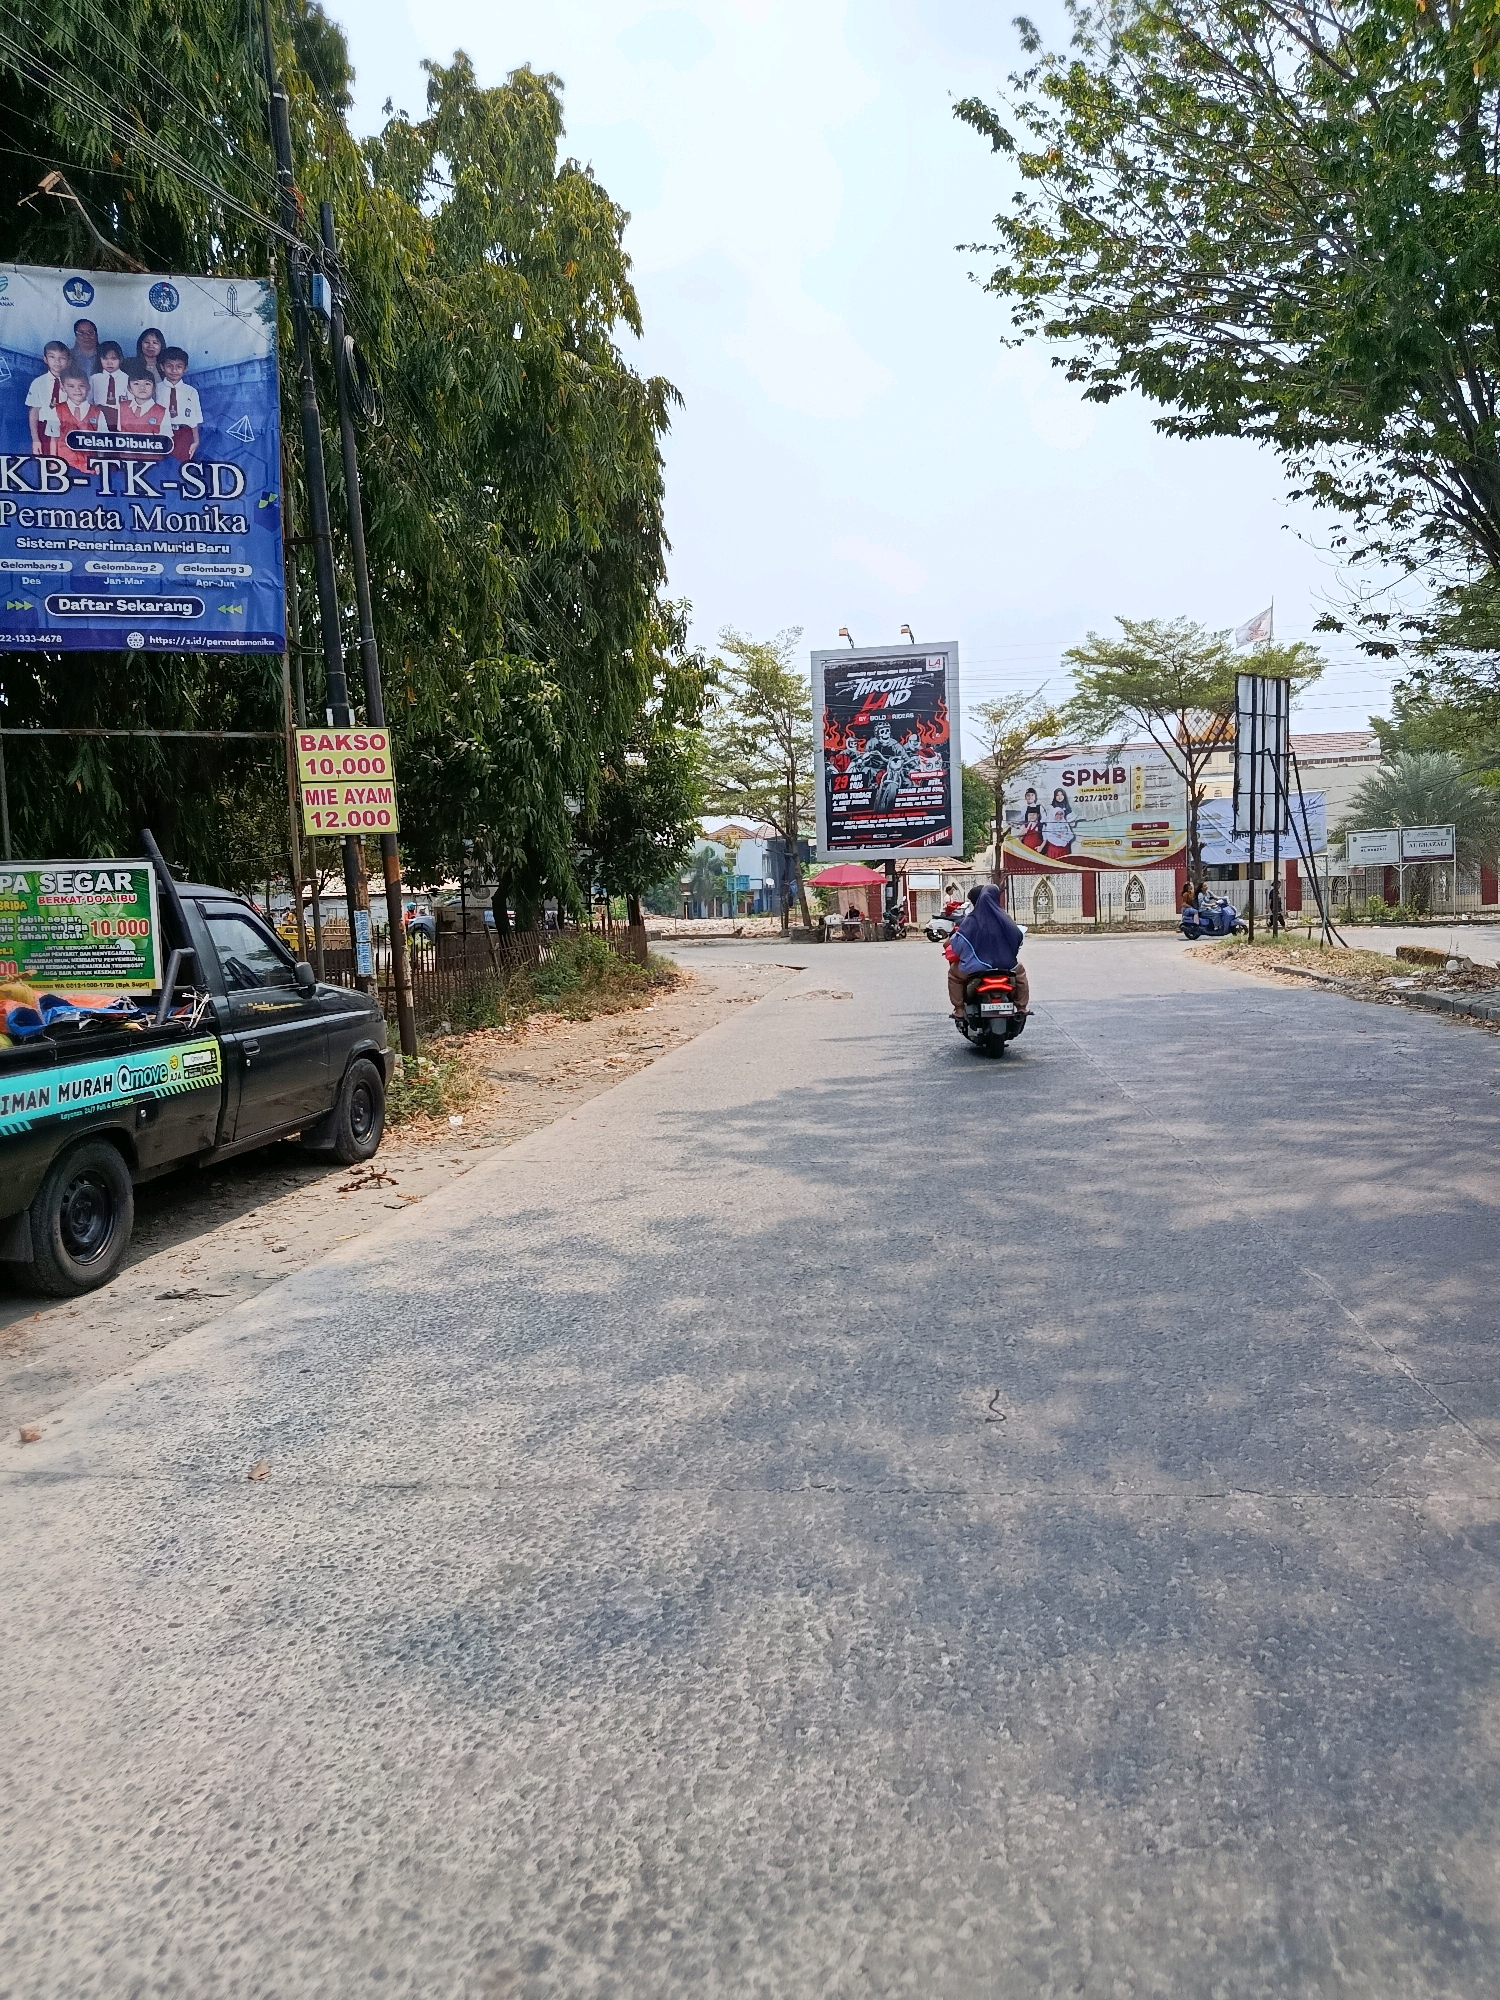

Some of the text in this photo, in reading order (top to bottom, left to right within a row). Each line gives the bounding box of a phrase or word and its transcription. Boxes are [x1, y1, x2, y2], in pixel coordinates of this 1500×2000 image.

[76, 435, 163, 450] Telah Dibuka
[0, 456, 246, 499] KB-TK-SD
[0, 501, 248, 534] Permata Monika
[16, 538, 230, 553] Sistem Penerimaan Murid Baru
[1, 561, 57, 570] Gelombang
[93, 563, 149, 572] Gelombang
[183, 565, 237, 574] Gelombang
[104, 577, 145, 585] Jan-Mar
[196, 580, 235, 588] Apr-Jun
[58, 599, 193, 615] Daftar Sekarang
[149, 636, 275, 647] https://s.id/permatamonika
[852, 675, 916, 701] THROTTLE
[860, 689, 912, 712] LAND
[300, 734, 386, 751] BAKSO
[834, 774, 849, 791] 29
[1062, 767, 1126, 787] SPMB
[305, 788, 392, 806] MIE AYAM
[1074, 794, 1119, 803] 2027/2028
[310, 810, 391, 828] 12.000
[923, 830, 948, 847] LIVE BOLD
[0, 872, 134, 894] PA SEGAR
[38, 896, 82, 905] BERKAT
[116, 894, 137, 903] IBU
[17, 916, 43, 924] lebih
[91, 919, 150, 936] 10.000
[17, 924, 37, 932] dan
[40, 924, 88, 934] menjaga
[17, 932, 48, 940] tahan
[52, 931, 83, 939] tubuh
[1, 1086, 50, 1115] IMAN
[58, 1073, 113, 1104] MURAH
[117, 1064, 168, 1092] Qmove
